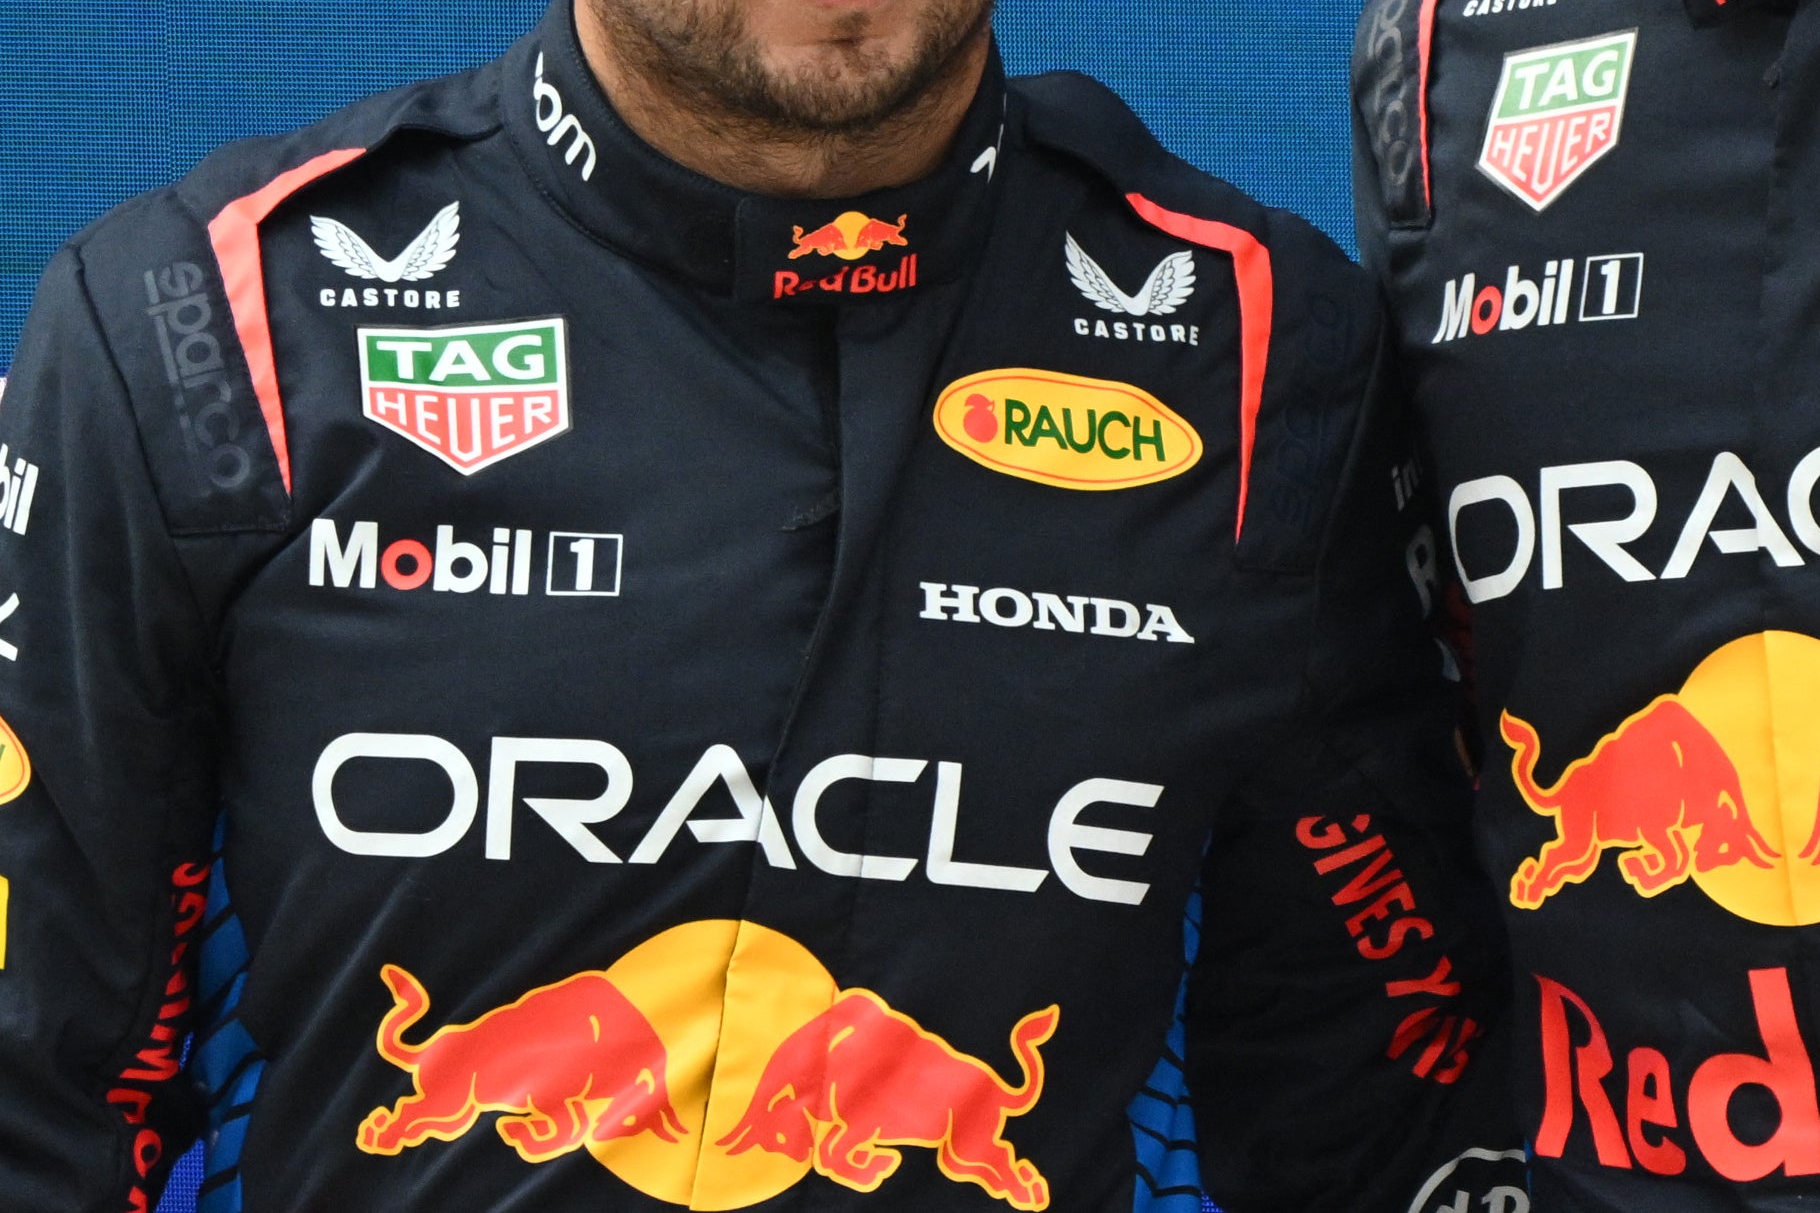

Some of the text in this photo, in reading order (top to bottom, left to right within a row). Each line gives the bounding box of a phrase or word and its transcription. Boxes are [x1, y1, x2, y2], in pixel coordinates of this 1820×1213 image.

[1515, 49, 1619, 111] TAG
[1491, 111, 1613, 193] HEUER
[320, 287, 462, 308] CASTORE
[850, 253, 918, 293] Bull
[1431, 259, 1621, 344] Mobil 1
[376, 334, 545, 381] TAG
[1074, 319, 1199, 346] CASTORE
[146, 261, 251, 489] sparco
[376, 390, 554, 462] HEUER
[1004, 398, 1166, 462] RAUCH
[309, 518, 593, 596] Mobil 1
[919, 579, 1196, 644] HONDA
[311, 731, 1166, 907] ORACLE
[1295, 813, 1435, 960] GIVES
